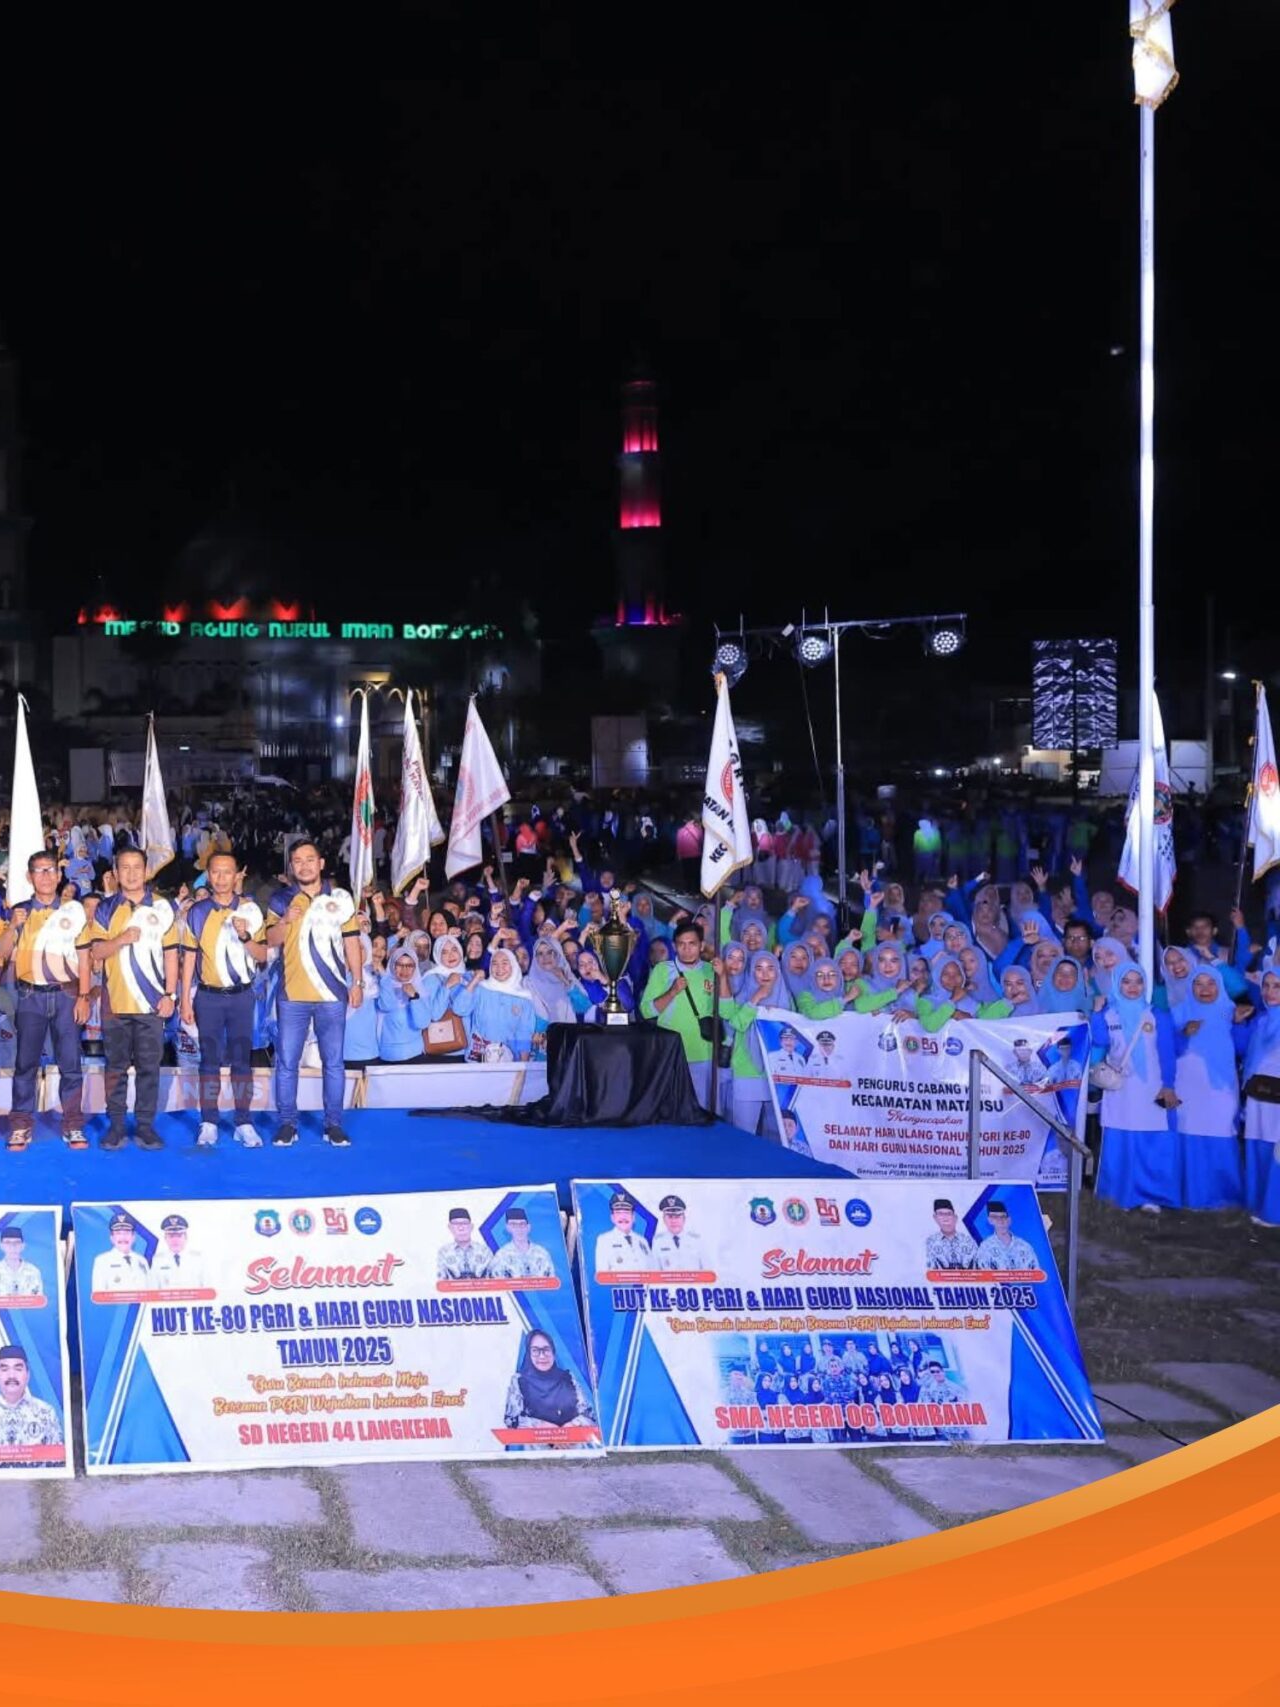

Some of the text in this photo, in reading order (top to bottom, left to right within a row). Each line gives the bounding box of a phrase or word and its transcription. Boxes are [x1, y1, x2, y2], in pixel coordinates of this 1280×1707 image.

[190, 621, 260, 637] AGUNG
[268, 621, 331, 638] NURUL
[341, 623, 394, 639] IMAN
[857, 1077, 915, 1093] PENGURUS
[917, 1081, 962, 1095] CABANG
[851, 1093, 933, 1112] KECAMATAN
[824, 1123, 873, 1138] SELAMAT
[874, 1125, 896, 1138] HARI
[897, 1126, 934, 1140] ULANG
[979, 1131, 1001, 1142] GRI
[828, 1139, 1026, 1157] DAN HARI GURU NASIONAL THUN 2025
[245, 1252, 405, 1295] Selamat
[761, 1248, 879, 1279] Selamat
[613, 1286, 1038, 1311] HUT KE-80 PGRI & HARI GURU NASIONAL TAHUN 2025
[151, 1296, 508, 1334] HUT KE-80 PGRI & HARI GURU NASIONAL
[735, 1316, 779, 1331] Indonesia
[780, 1316, 806, 1332] Maju
[276, 1336, 394, 1366] TAHUN 2025
[337, 1372, 393, 1389] Indonesia
[394, 1370, 429, 1389] Maju
[269, 1395, 310, 1414] PGRI
[372, 1392, 428, 1409] Indonesia
[715, 1401, 988, 1430] SMA NEGERI 06 BOMBANA
[238, 1417, 453, 1445] SD NEGERI 44 LANGKEMA
